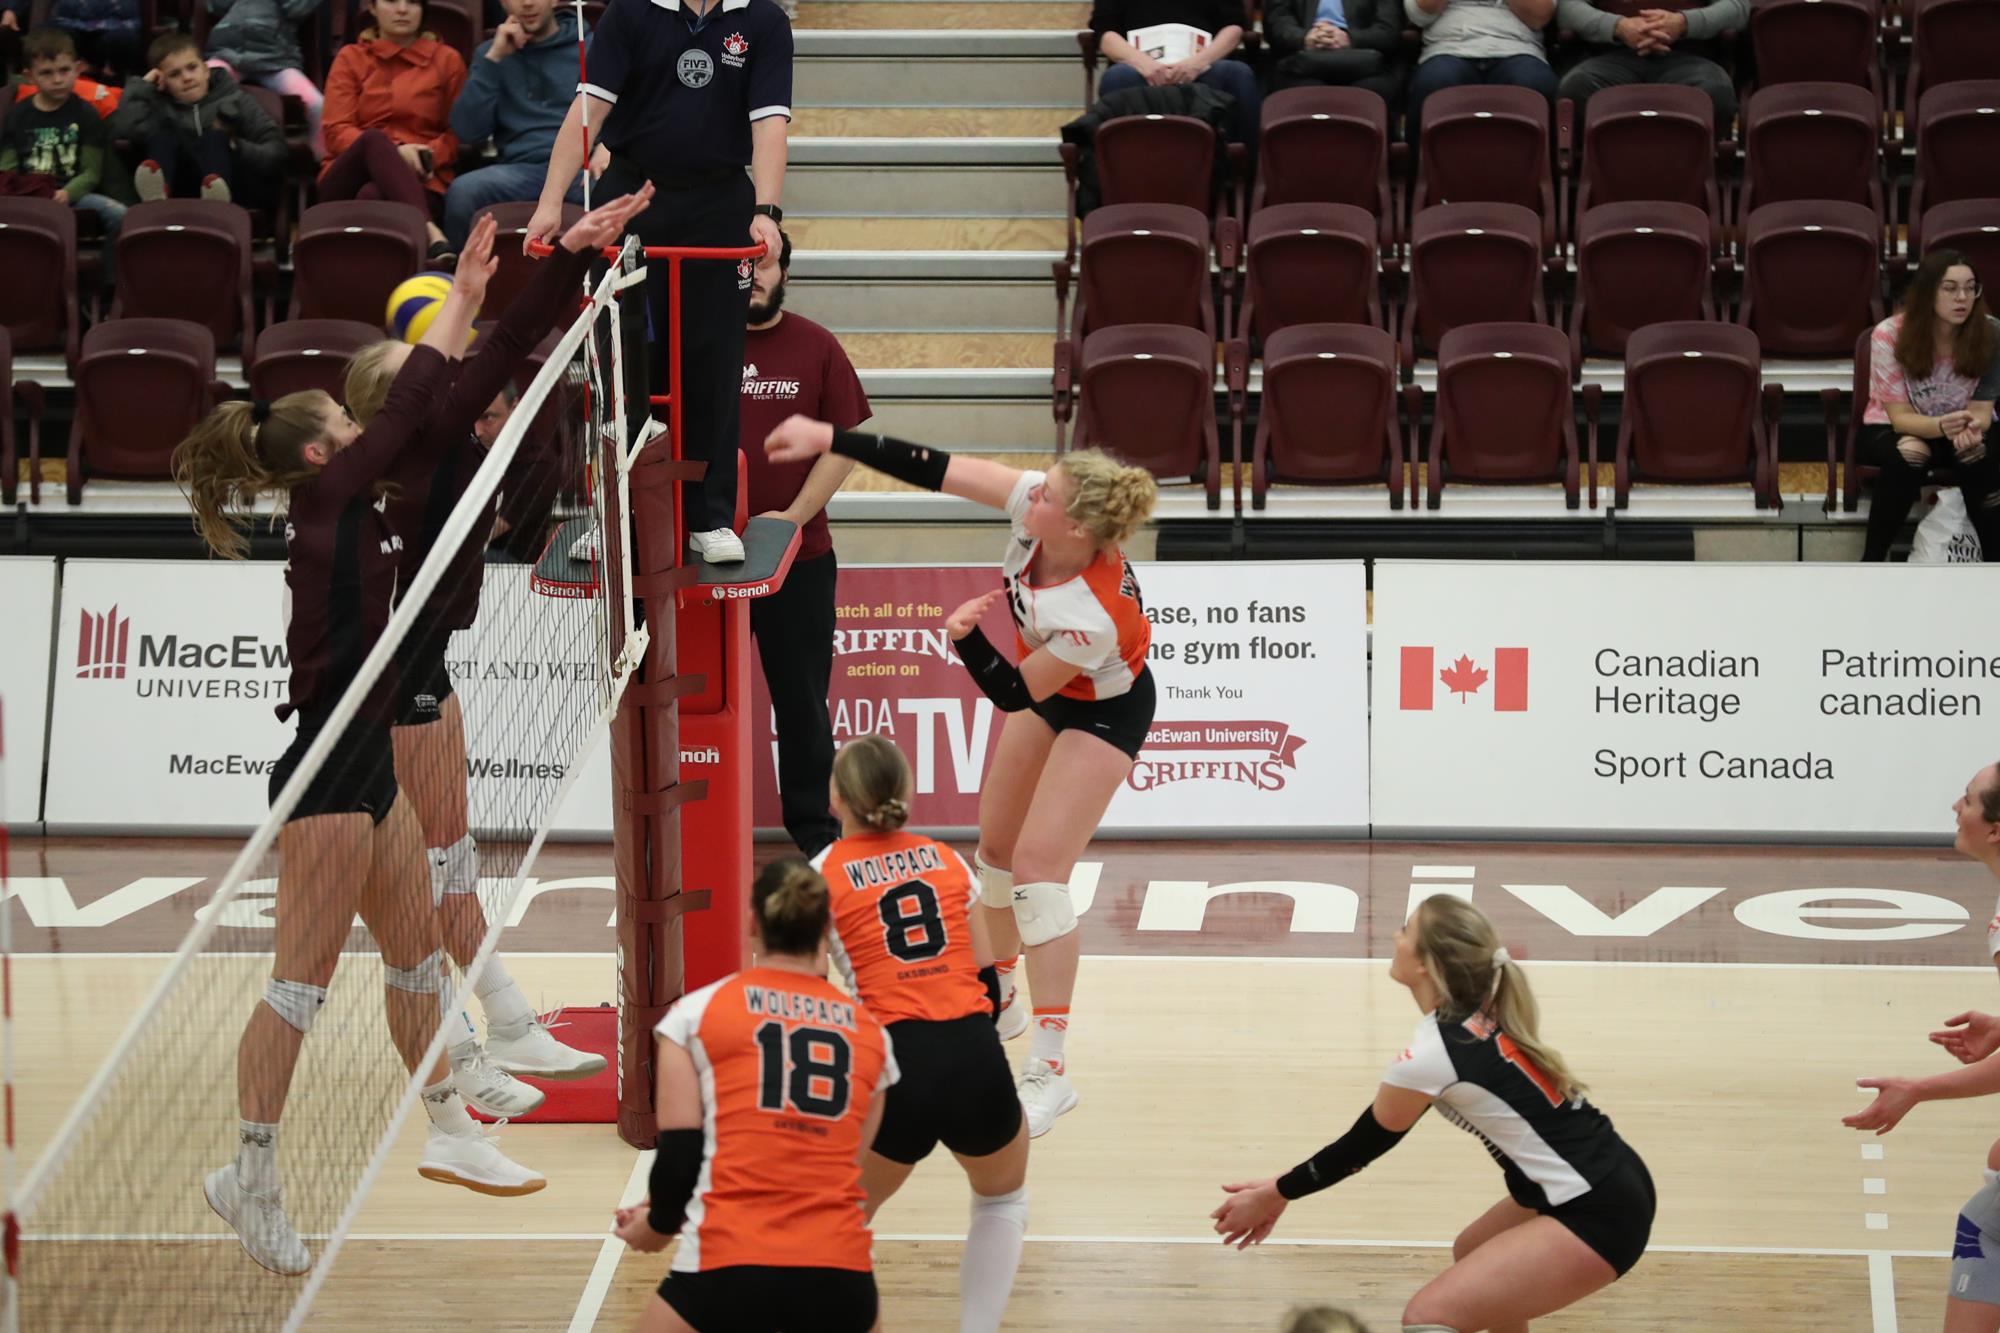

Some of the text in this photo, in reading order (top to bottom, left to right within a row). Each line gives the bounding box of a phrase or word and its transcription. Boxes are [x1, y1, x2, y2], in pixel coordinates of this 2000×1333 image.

[721, 58, 743, 68] Canada
[741, 381, 800, 394] RIFFINS
[727, 583, 770, 599] Senoh
[835, 603, 943, 618] atch all of the
[1146, 600, 1306, 627] ase, no fans
[138, 634, 291, 669] MacEw
[832, 628, 966, 667] RIFFIN
[1184, 641, 1240, 665] gym
[1249, 636, 1316, 659] floor.
[483, 662, 539, 680] AND
[847, 662, 920, 677] action on
[1594, 648, 1760, 678] Canadian
[136, 679, 288, 699] UNIVERSIT
[1165, 686, 1243, 699] Thank You
[1819, 688, 1982, 716] canadien
[1594, 686, 1741, 722] Heritage
[898, 698, 994, 793] TV
[1145, 728, 1279, 746] acEwan University
[169, 754, 277, 776] MacEwa
[467, 758, 565, 779] Wellnes
[679, 748, 720, 764] noh
[1593, 749, 1835, 784] Sport Canada
[1126, 760, 1286, 792] GRIFFINS
[843, 845, 948, 892] WOLFPACK
[877, 876, 950, 964] 8
[743, 985, 859, 1033] WOLFPACK
[752, 1018, 855, 1122] 18
